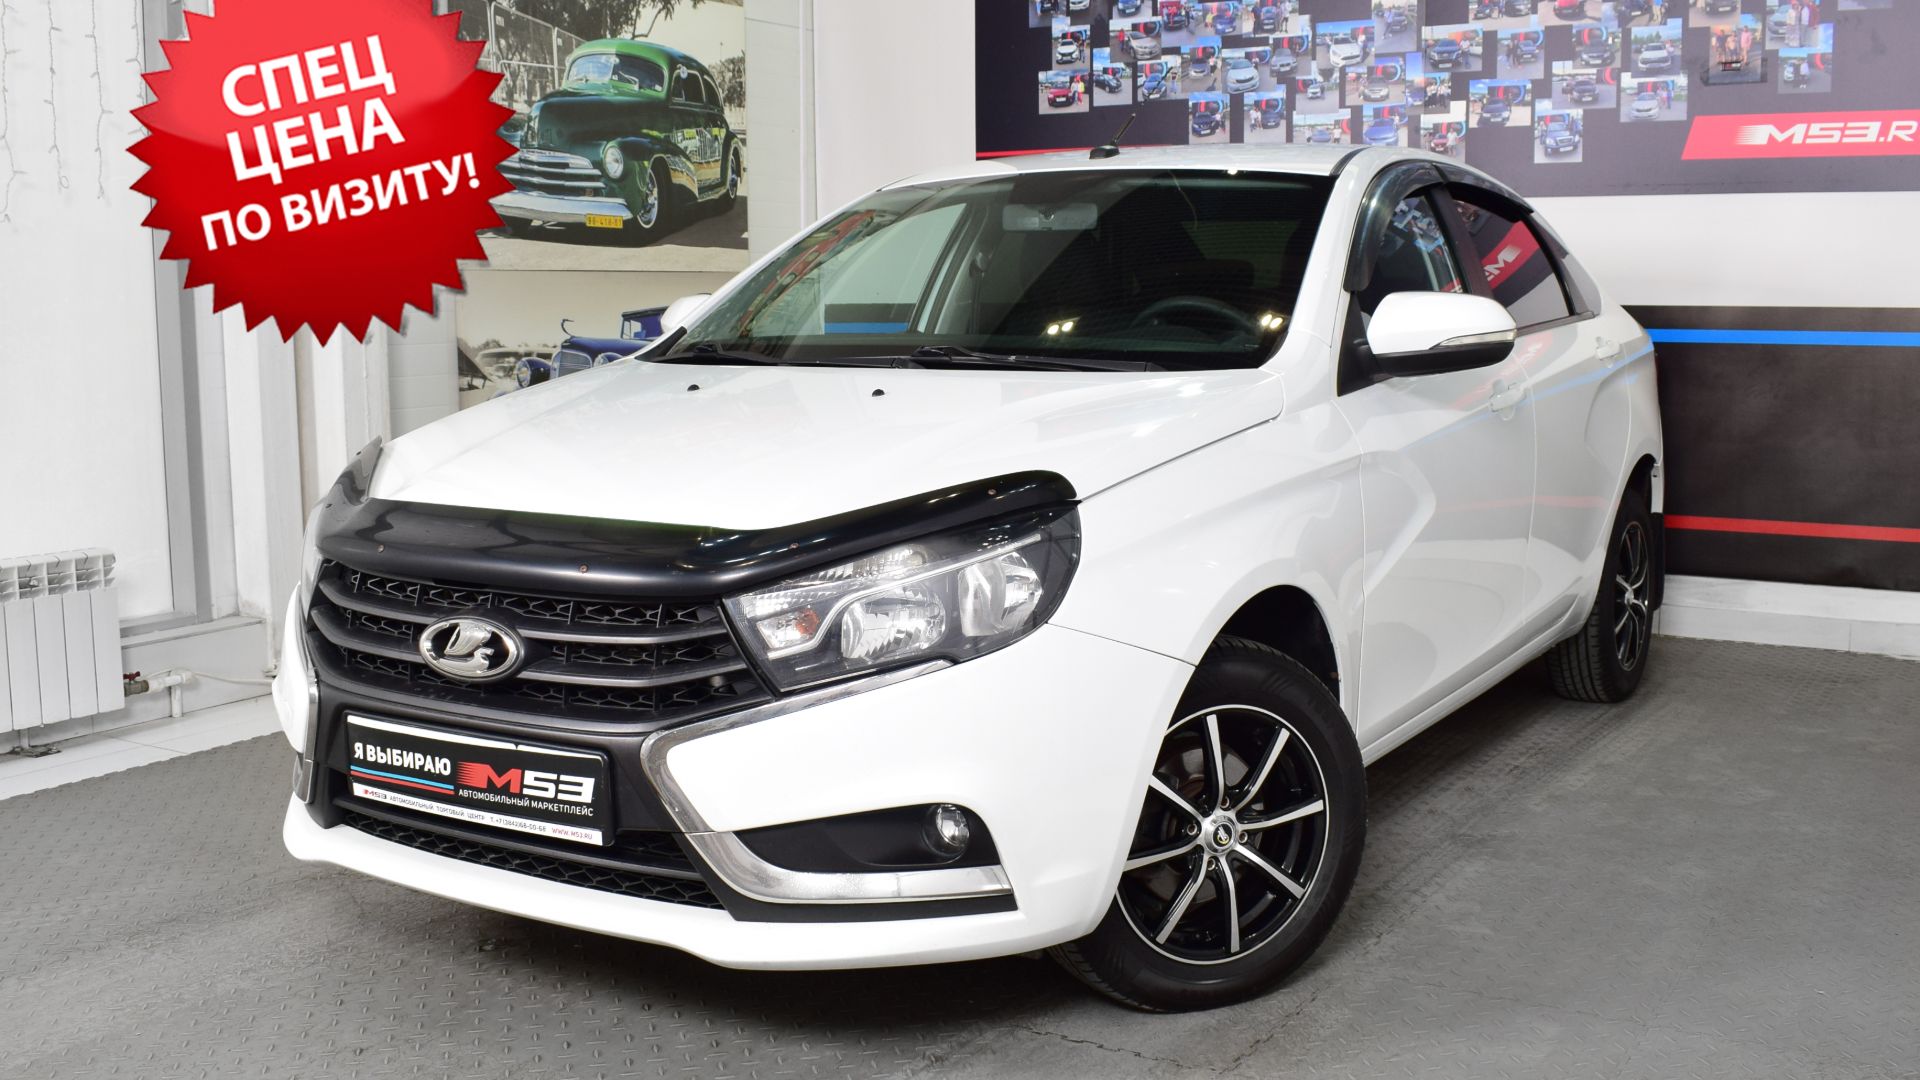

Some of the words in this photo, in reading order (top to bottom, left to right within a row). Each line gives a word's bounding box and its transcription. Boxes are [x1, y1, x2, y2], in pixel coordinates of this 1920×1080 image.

[354, 741, 364, 760] Я
[366, 744, 451, 776] ВЫБИРАЮ
[458, 789, 530, 807] АВТОМОБИЛЬНЫЙ
[531, 800, 594, 816] МАРКЕТПЛЕЙС
